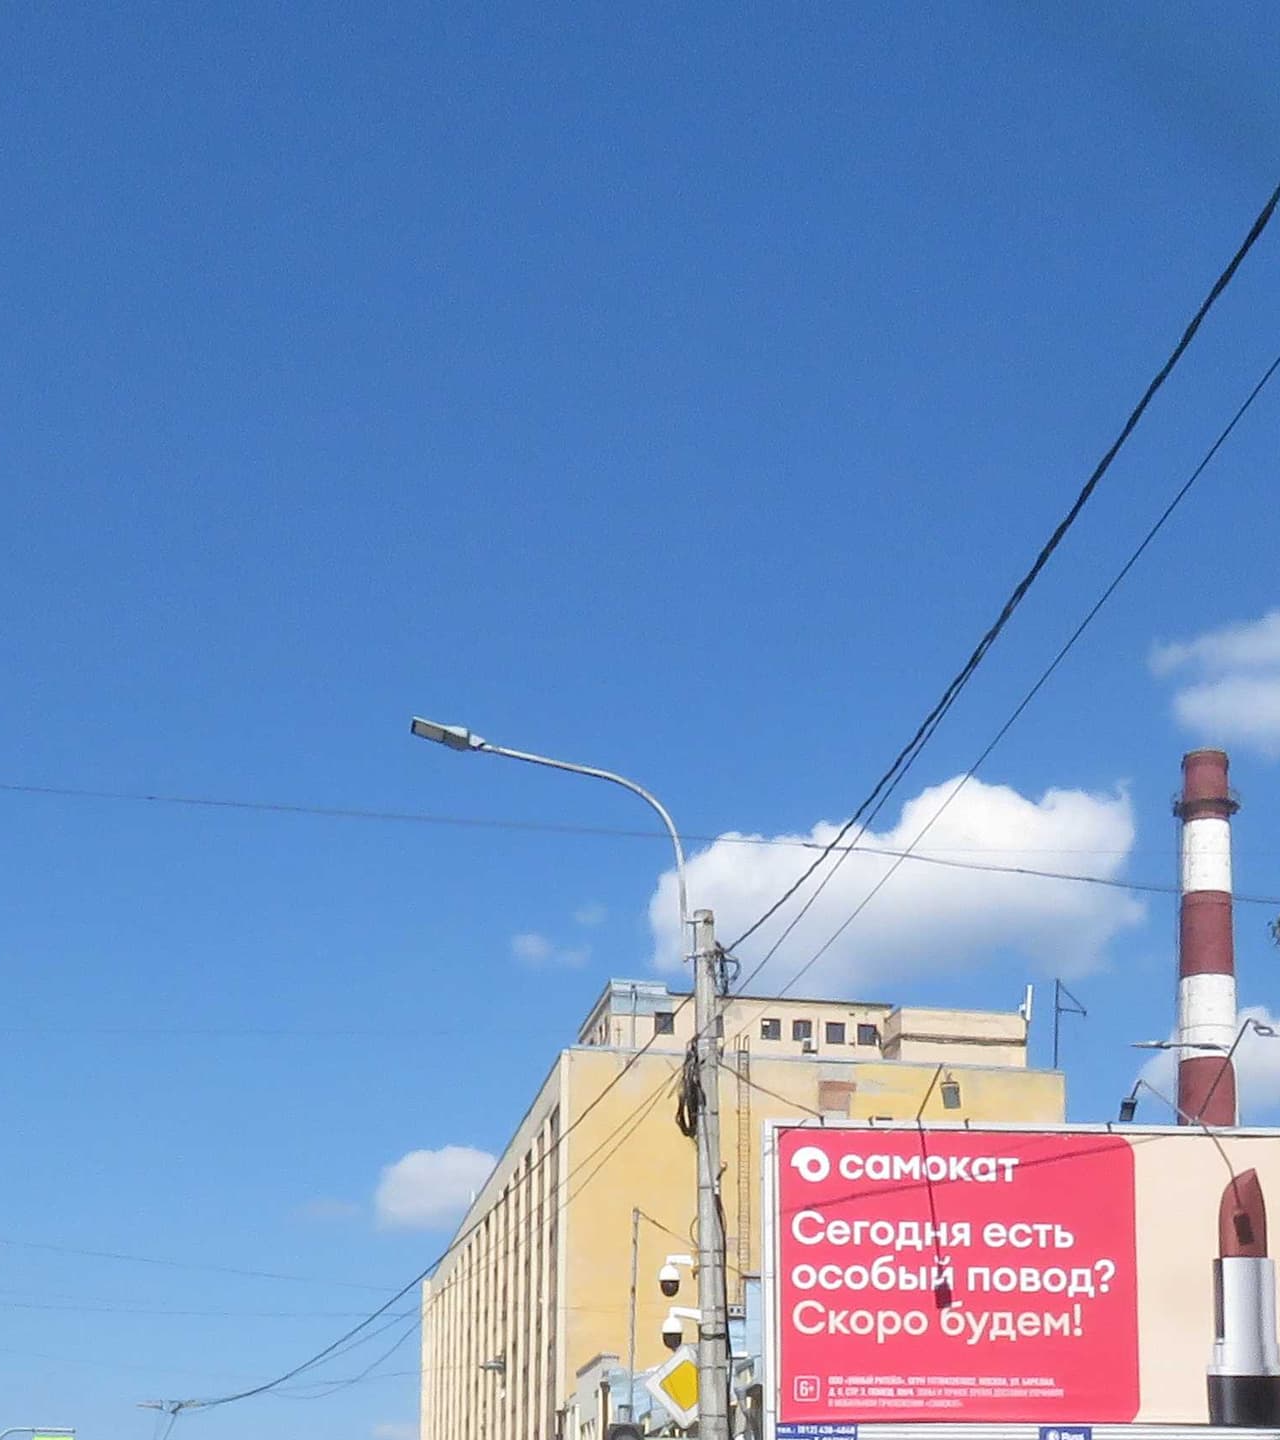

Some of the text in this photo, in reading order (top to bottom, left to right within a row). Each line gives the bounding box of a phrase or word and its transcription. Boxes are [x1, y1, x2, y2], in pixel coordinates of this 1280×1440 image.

[838, 1153, 1020, 1183] самокат
[791, 1210, 1075, 1252] Сегодня есть
[791, 1255, 1116, 1299] особый повод?
[792, 1300, 1083, 1345] Скоро будем!
[800, 1380, 816, 1397] 6+
